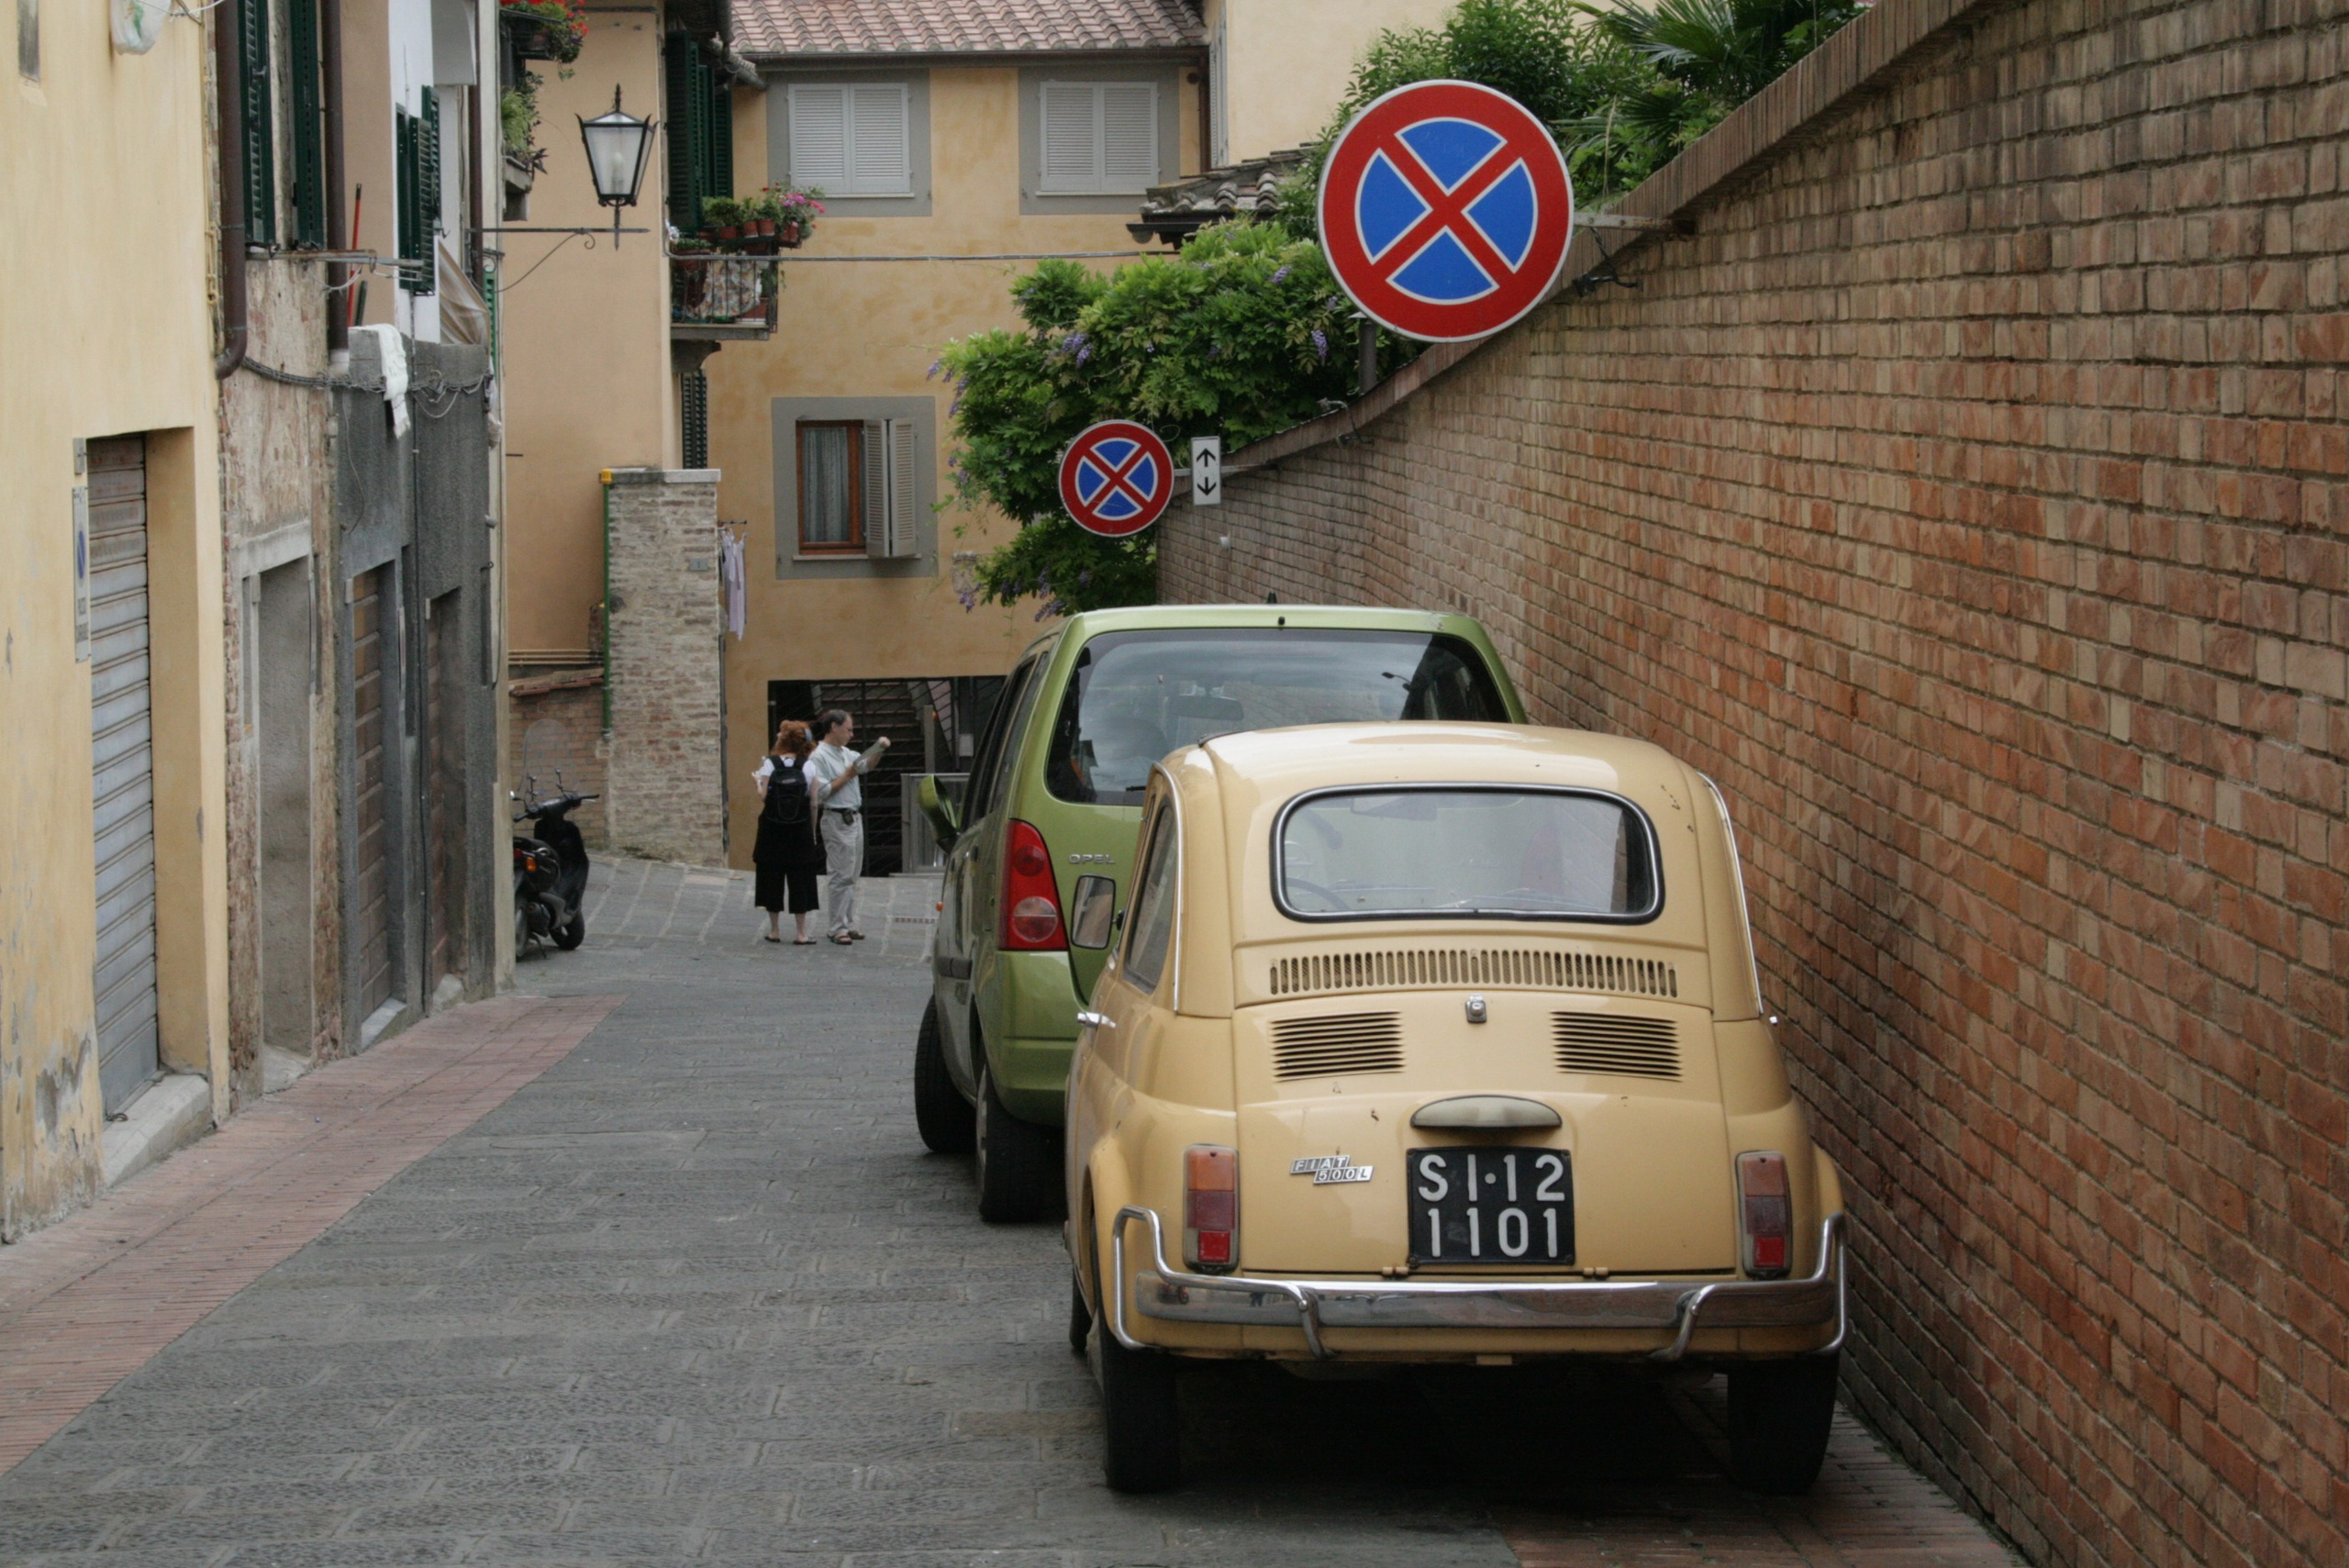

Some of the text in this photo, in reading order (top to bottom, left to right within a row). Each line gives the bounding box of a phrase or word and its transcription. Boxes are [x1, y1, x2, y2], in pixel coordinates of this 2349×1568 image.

[1069, 854, 1116, 865] OPEL
[1294, 1156, 1346, 1172] FIAT
[1318, 1167, 1369, 1182] 500L
[1428, 1207, 1558, 1258] 1101
